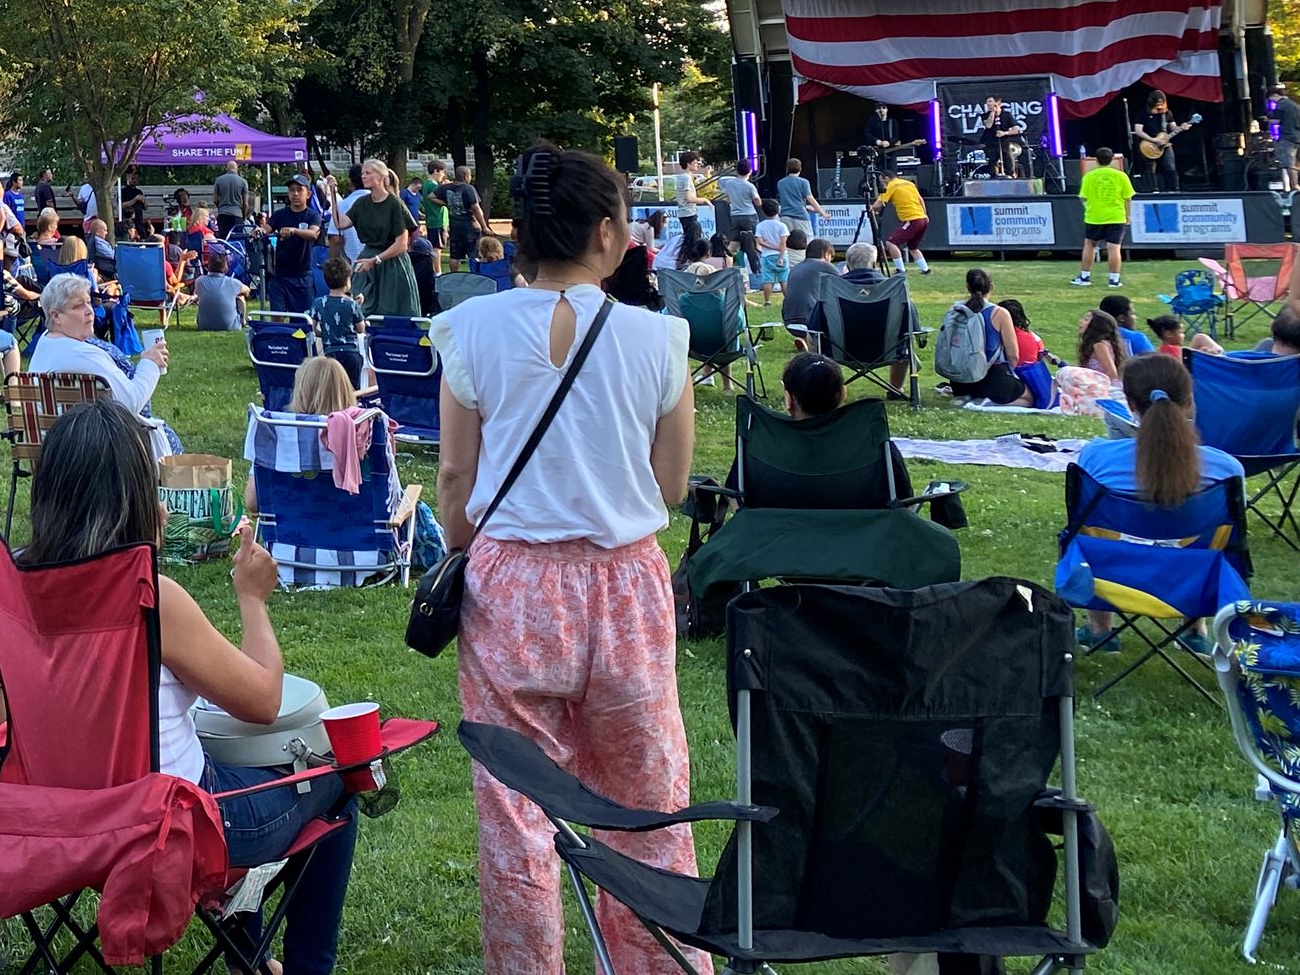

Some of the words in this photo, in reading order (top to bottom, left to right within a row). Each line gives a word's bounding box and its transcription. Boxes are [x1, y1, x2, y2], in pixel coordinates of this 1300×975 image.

[948, 101, 1043, 119] CHAGING
[172, 149, 203, 157] SHARE
[994, 205, 1029, 216] summit
[1181, 203, 1219, 213] summit
[994, 215, 1048, 227] community
[1181, 213, 1238, 225] community
[995, 225, 1042, 237] programs
[1182, 224, 1232, 235] programs
